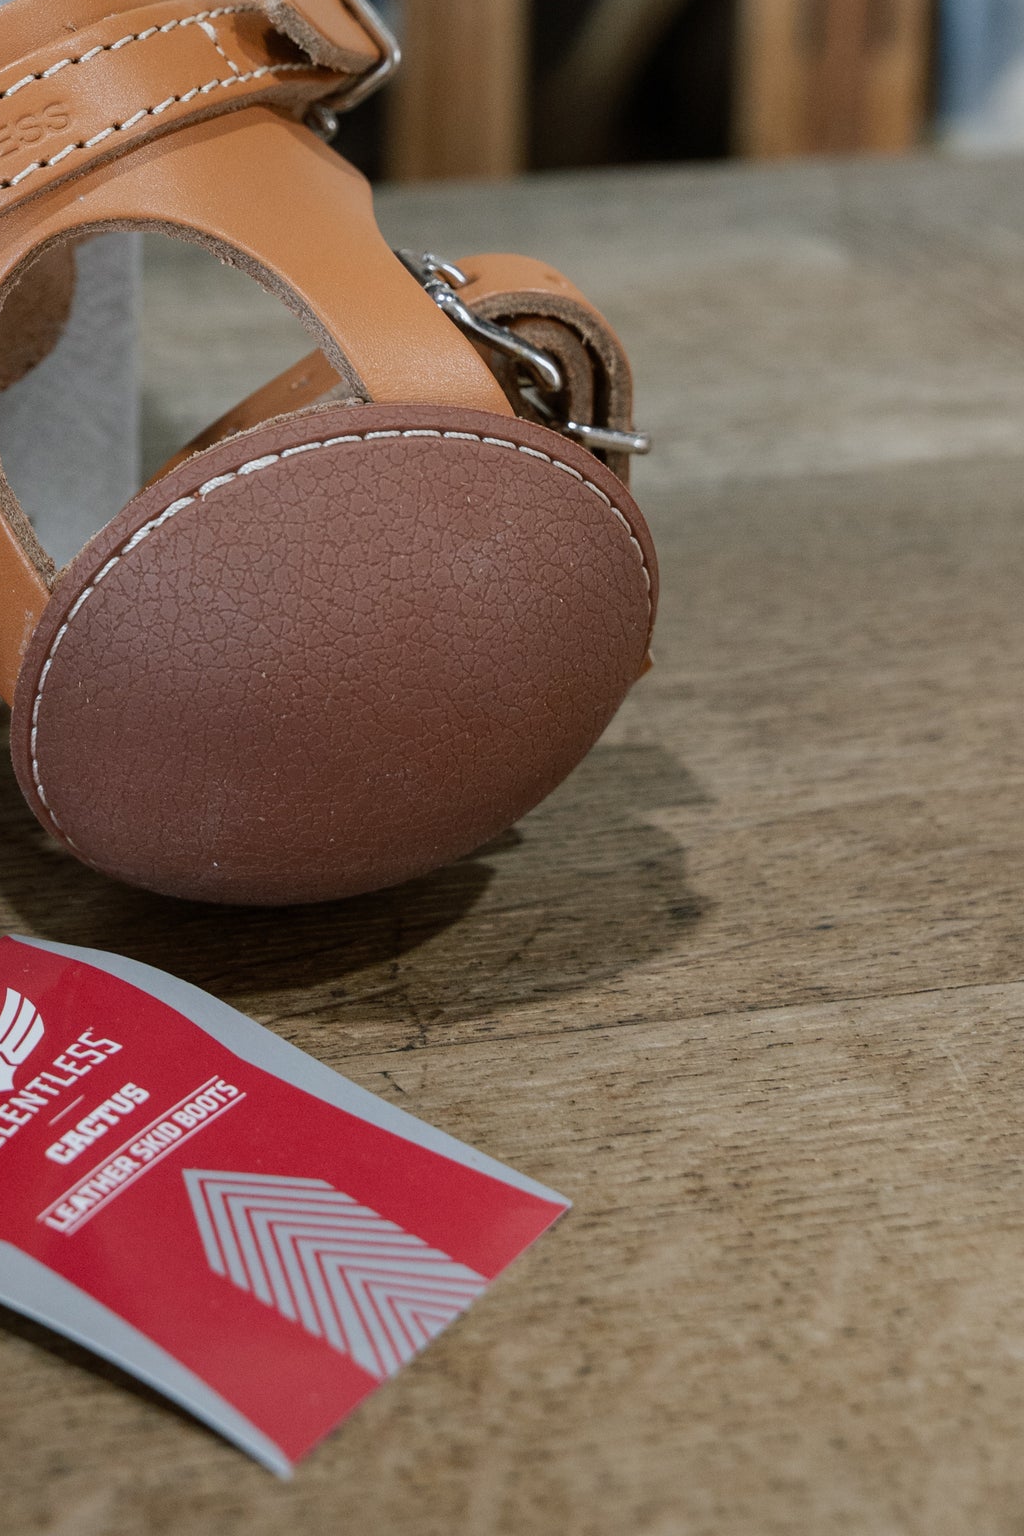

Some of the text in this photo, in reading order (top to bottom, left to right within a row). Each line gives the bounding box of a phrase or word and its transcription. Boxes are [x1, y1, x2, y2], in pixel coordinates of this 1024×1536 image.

[45, 1082, 150, 1165] CACTUS
[45, 1080, 239, 1232] LEATHER SKID BOOTS
